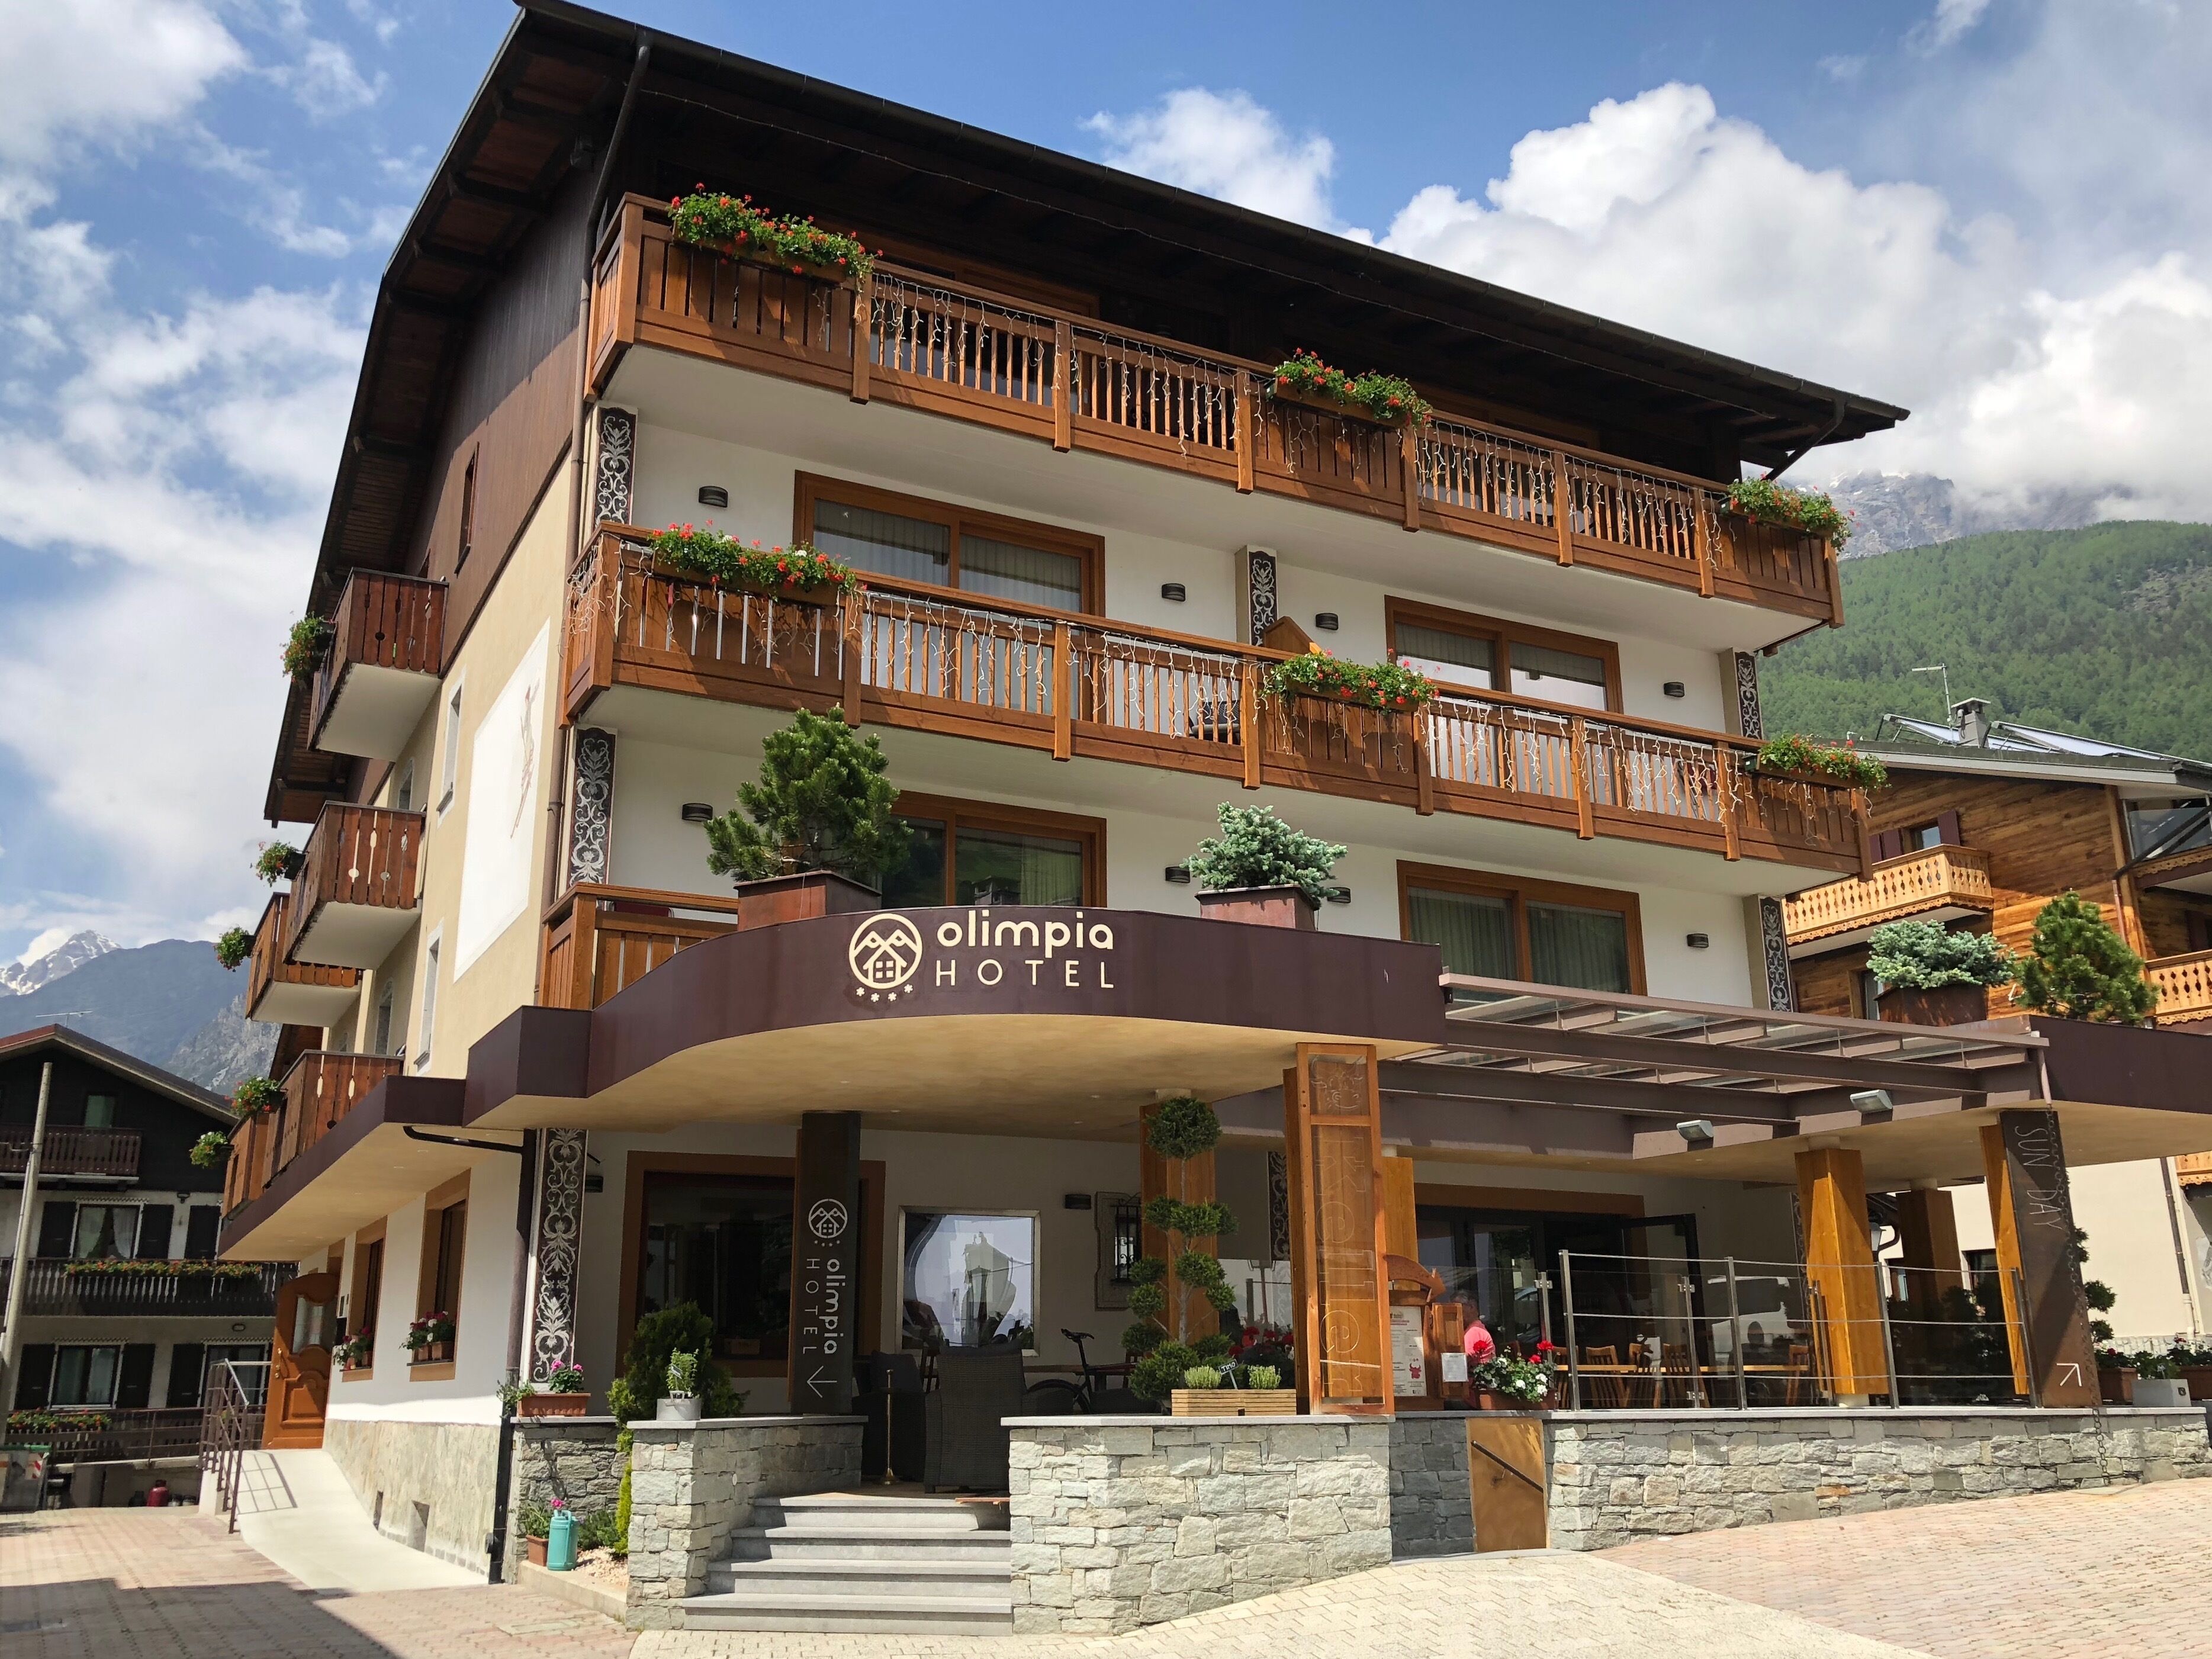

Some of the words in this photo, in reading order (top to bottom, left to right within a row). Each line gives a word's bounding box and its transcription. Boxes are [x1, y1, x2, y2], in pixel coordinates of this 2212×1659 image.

[937, 910, 1113, 958] olimpia
[935, 959, 1114, 988] HOTEL
[2014, 1126, 2053, 1167] SUN
[2027, 1190, 2063, 1230] DAY
[803, 1258, 820, 1354] HOTEL
[819, 1259, 846, 1354] olimpia
